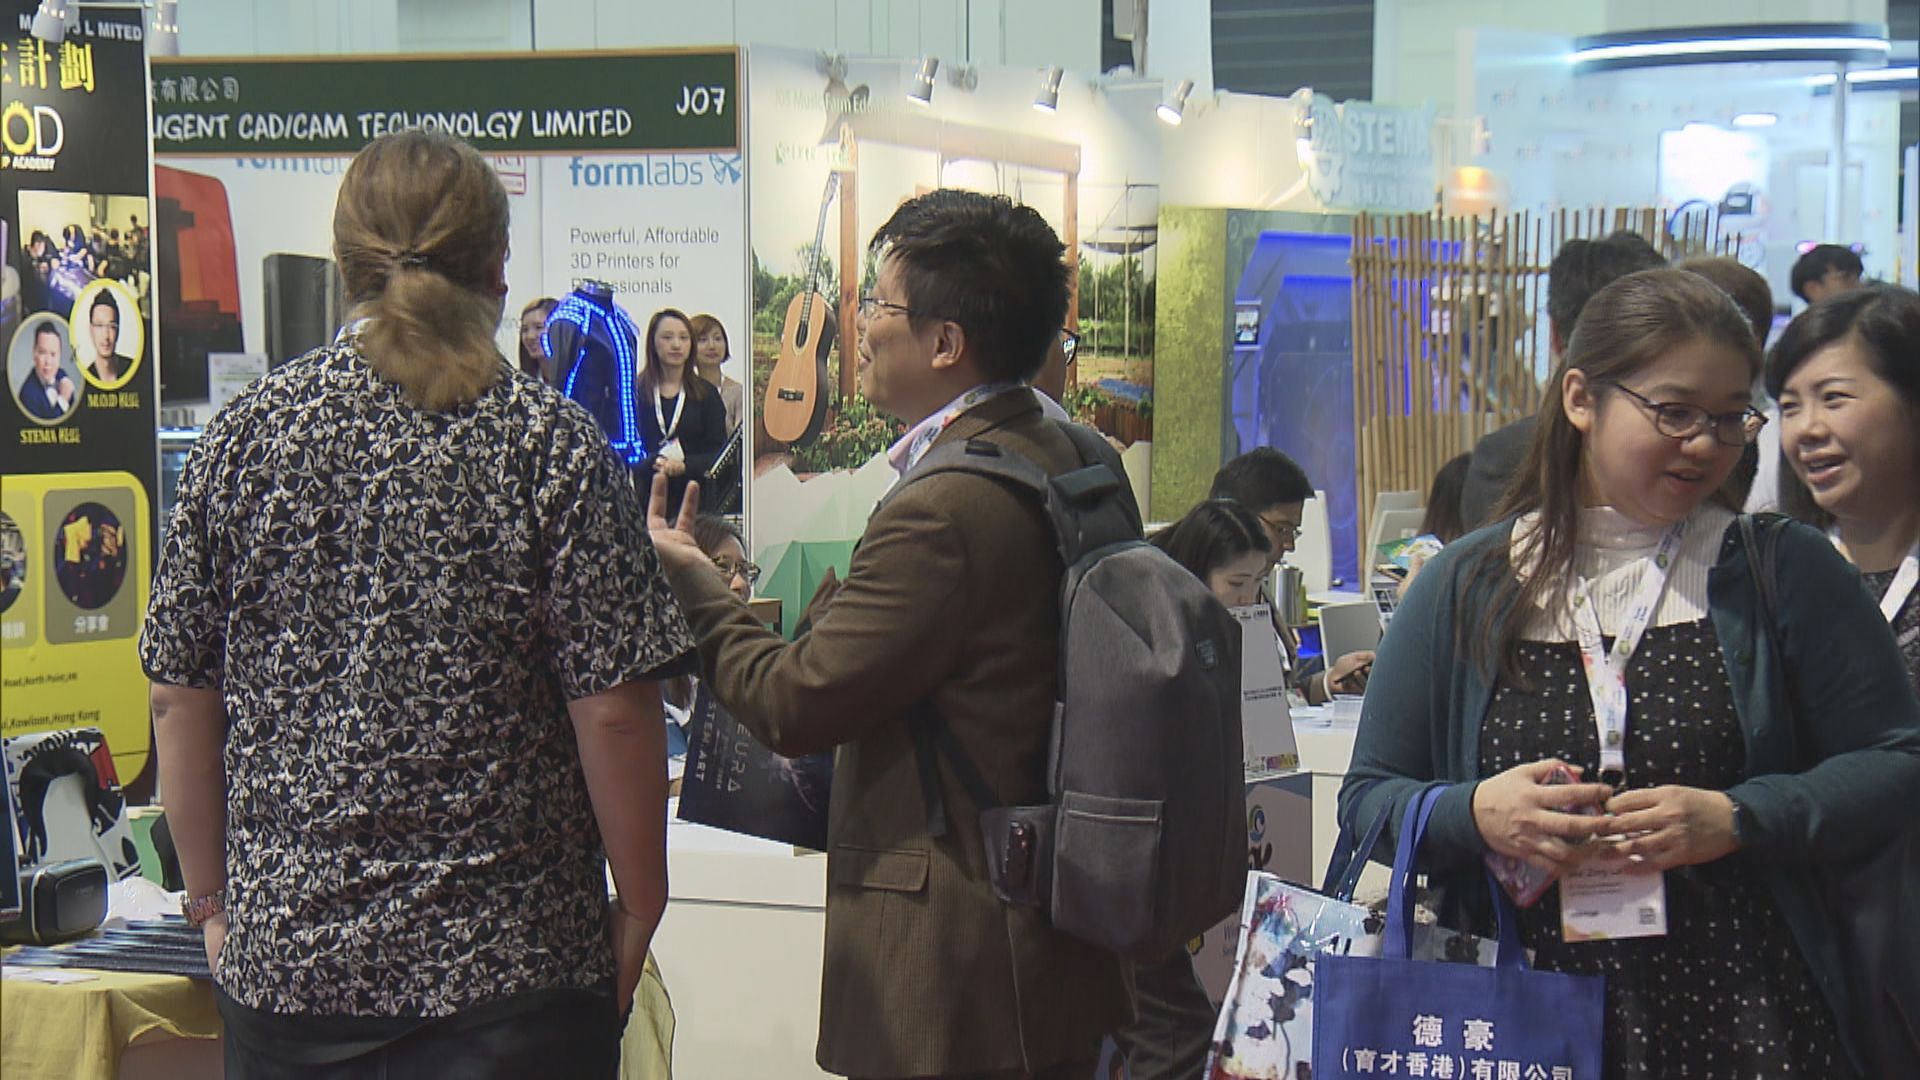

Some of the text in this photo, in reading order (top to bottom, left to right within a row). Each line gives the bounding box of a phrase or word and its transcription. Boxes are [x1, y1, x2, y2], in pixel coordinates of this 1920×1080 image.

[153, 113, 230, 142] IGENT
[238, 112, 350, 142] CAD/CAM
[531, 108, 632, 137] LIMITED
[569, 154, 703, 187] formlabs
[570, 227, 719, 246] Powerful, Affordable
[571, 251, 680, 269] 3D Printers for
